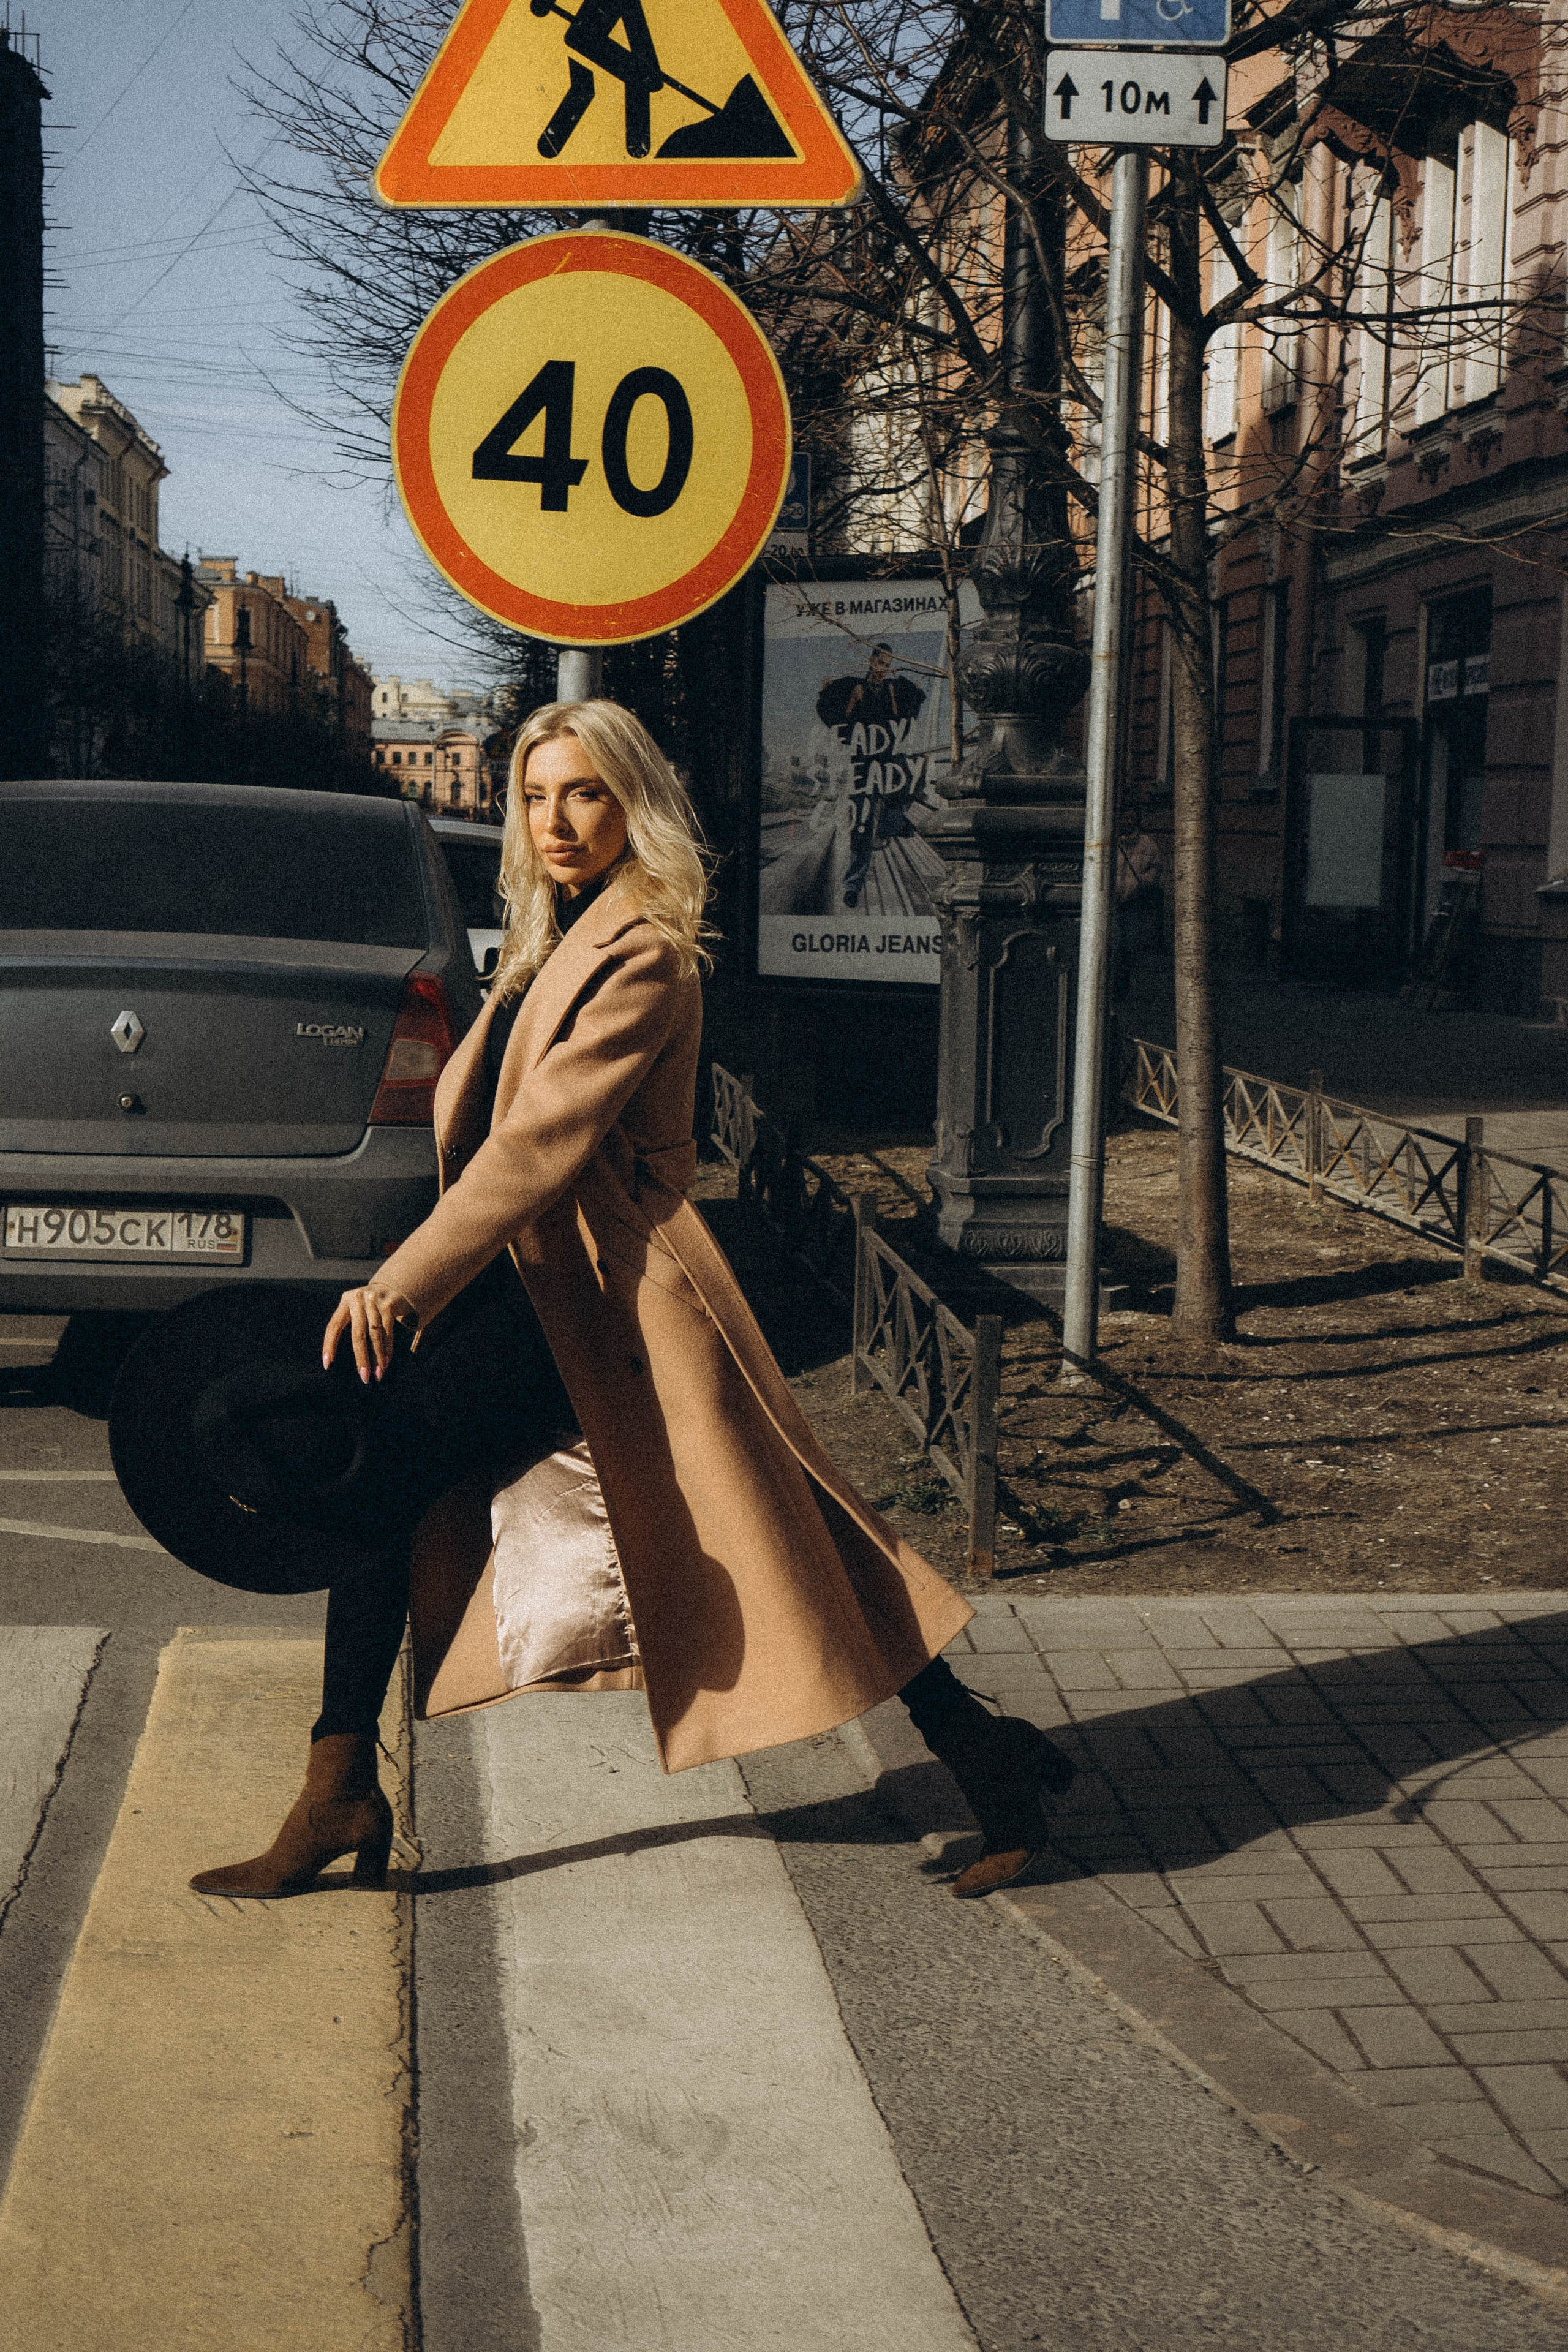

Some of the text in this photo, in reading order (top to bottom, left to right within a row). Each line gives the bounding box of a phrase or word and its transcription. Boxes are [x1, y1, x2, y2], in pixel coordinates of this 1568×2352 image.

[471, 359, 694, 518] 40
[835, 601, 845, 616] В
[850, 596, 948, 615] МАГАЗИНАХ
[792, 933, 943, 954] GLORIA JEANS
[296, 1022, 364, 1040] LOGAN
[178, 1213, 232, 1239] 178
[187, 1239, 216, 1250] RUS
